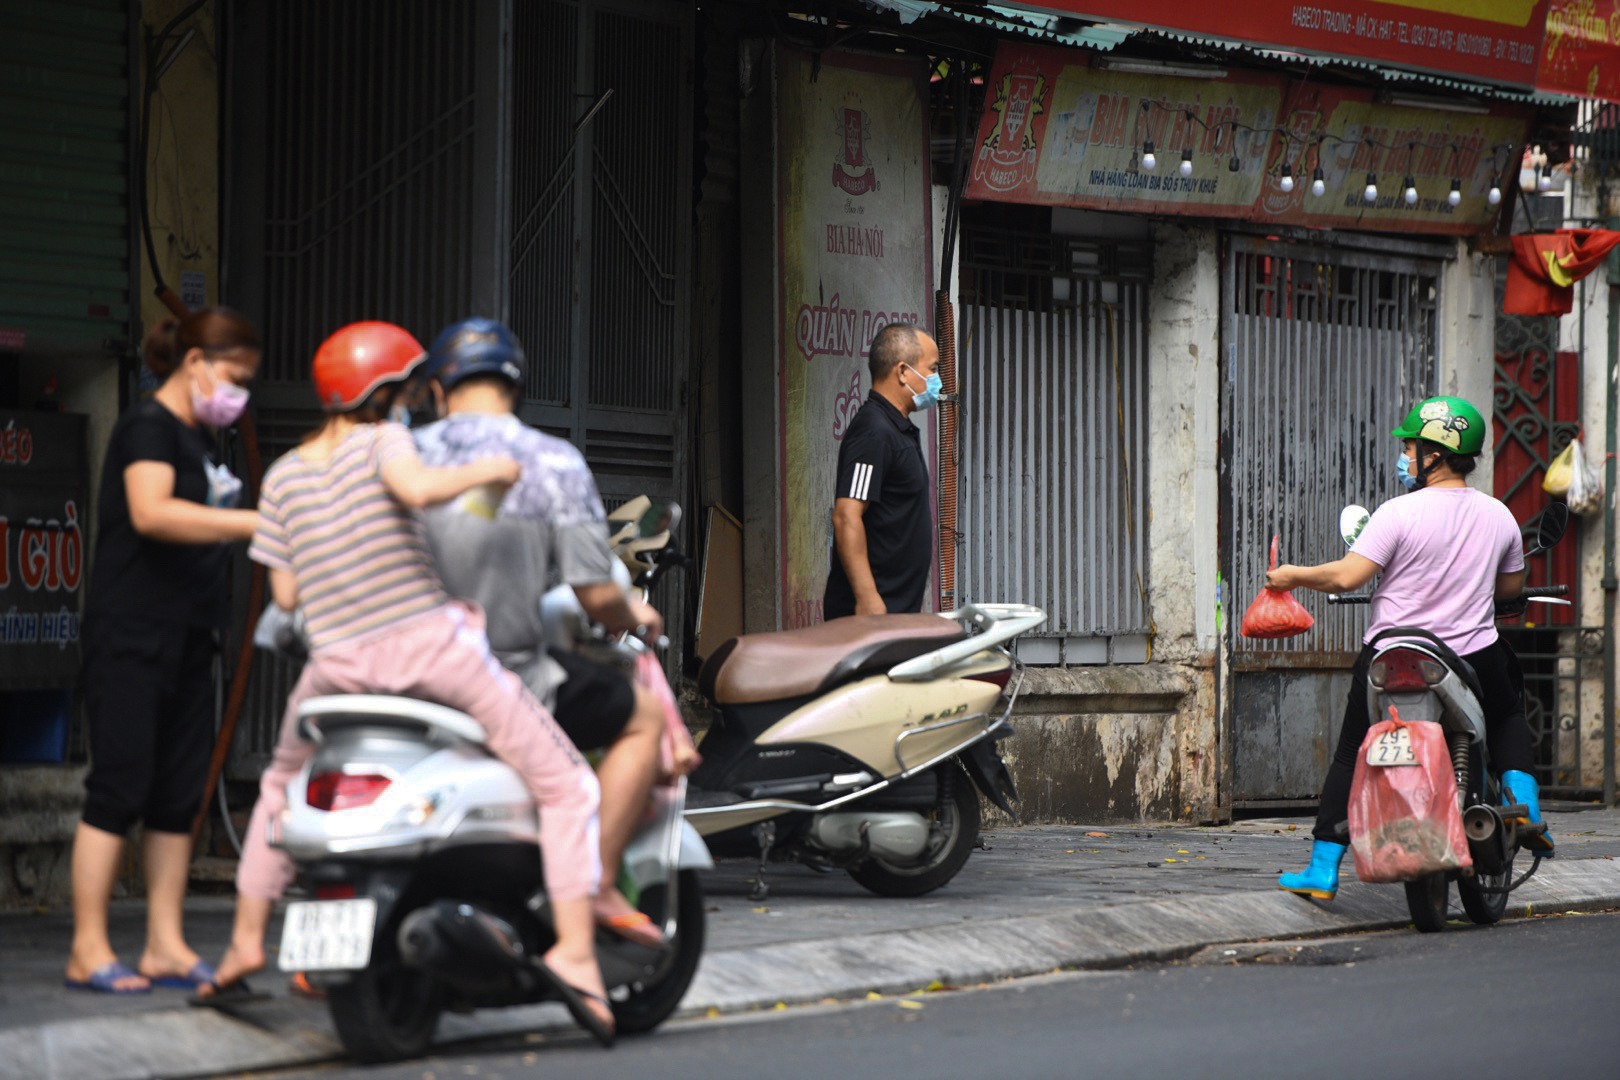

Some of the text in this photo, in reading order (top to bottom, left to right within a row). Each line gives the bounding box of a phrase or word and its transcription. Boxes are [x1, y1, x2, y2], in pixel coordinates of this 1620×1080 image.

[1291, 6, 1321, 29] HABECO
[1322, 10, 1352, 34] TRADING
[843, 178, 865, 191] HABECO
[989, 167, 1018, 185] HABECO
[1149, 175, 1161, 190] BIA
[826, 222, 884, 261] BIA HÀ NỘI
[796, 292, 857, 361] QUÁN
[0, 419, 33, 464] ÉO
[41, 605, 80, 650] HIỆU
